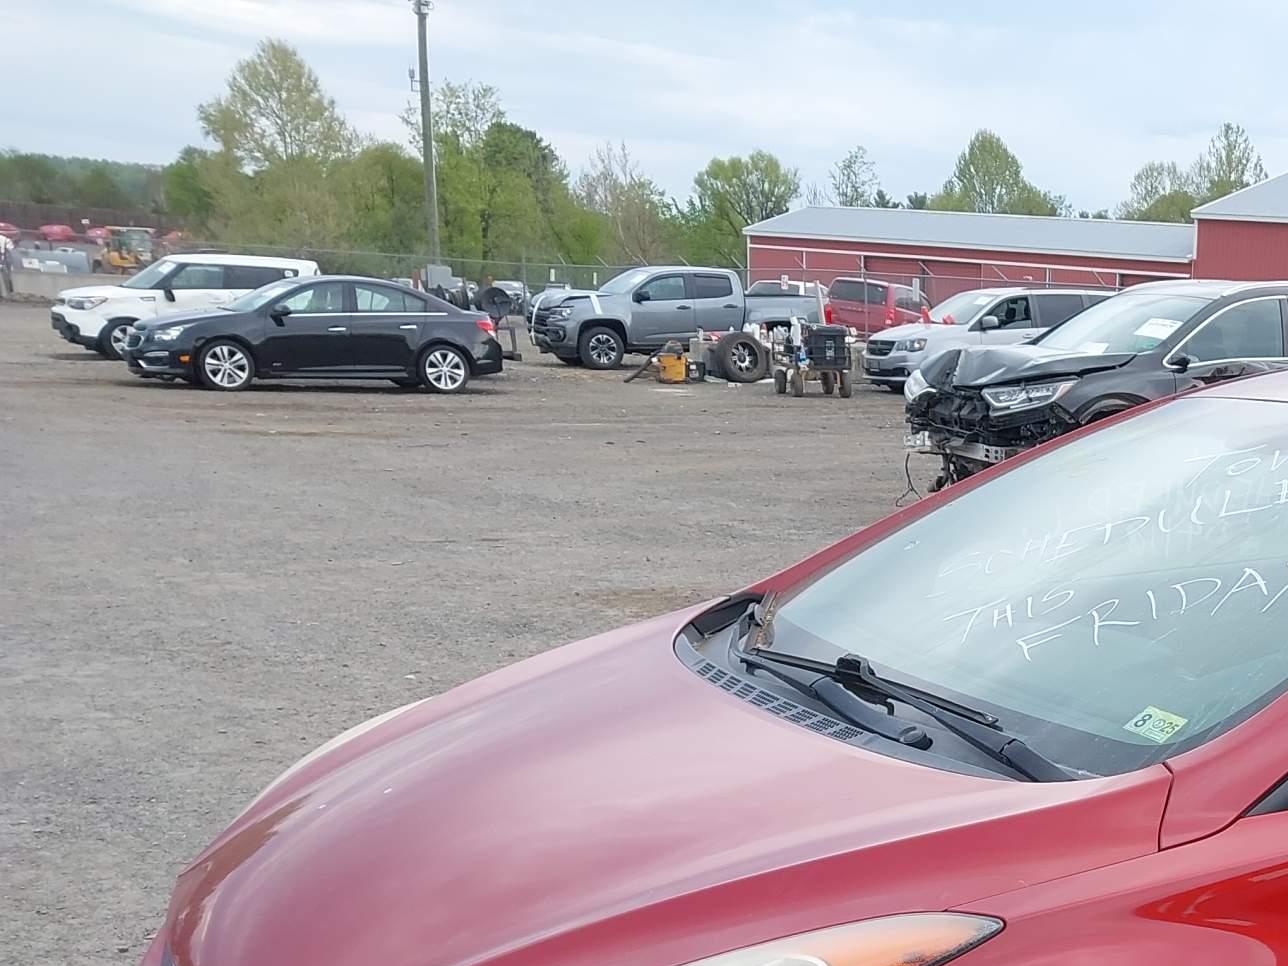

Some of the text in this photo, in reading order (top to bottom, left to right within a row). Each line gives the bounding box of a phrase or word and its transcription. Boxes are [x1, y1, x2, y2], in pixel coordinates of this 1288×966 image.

[943, 577, 1082, 644] THIS
[1133, 713, 1153, 728] 8
[1159, 721, 1180, 735] 25
